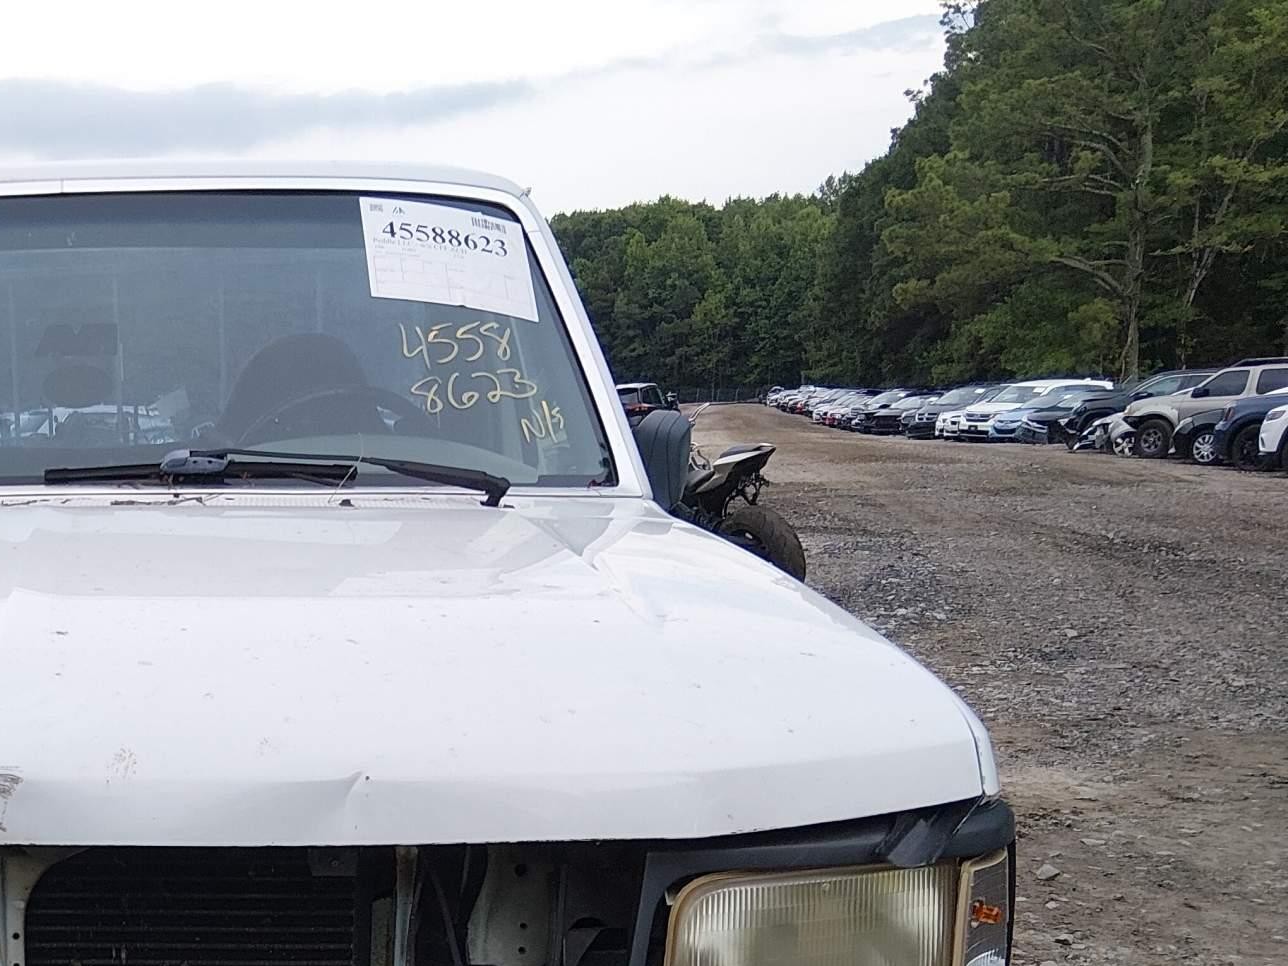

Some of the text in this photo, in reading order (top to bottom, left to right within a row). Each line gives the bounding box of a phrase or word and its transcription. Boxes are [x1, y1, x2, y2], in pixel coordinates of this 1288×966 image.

[382, 221, 508, 257] 45588623
[400, 321, 512, 368] 4558
[411, 369, 537, 413] 8623
